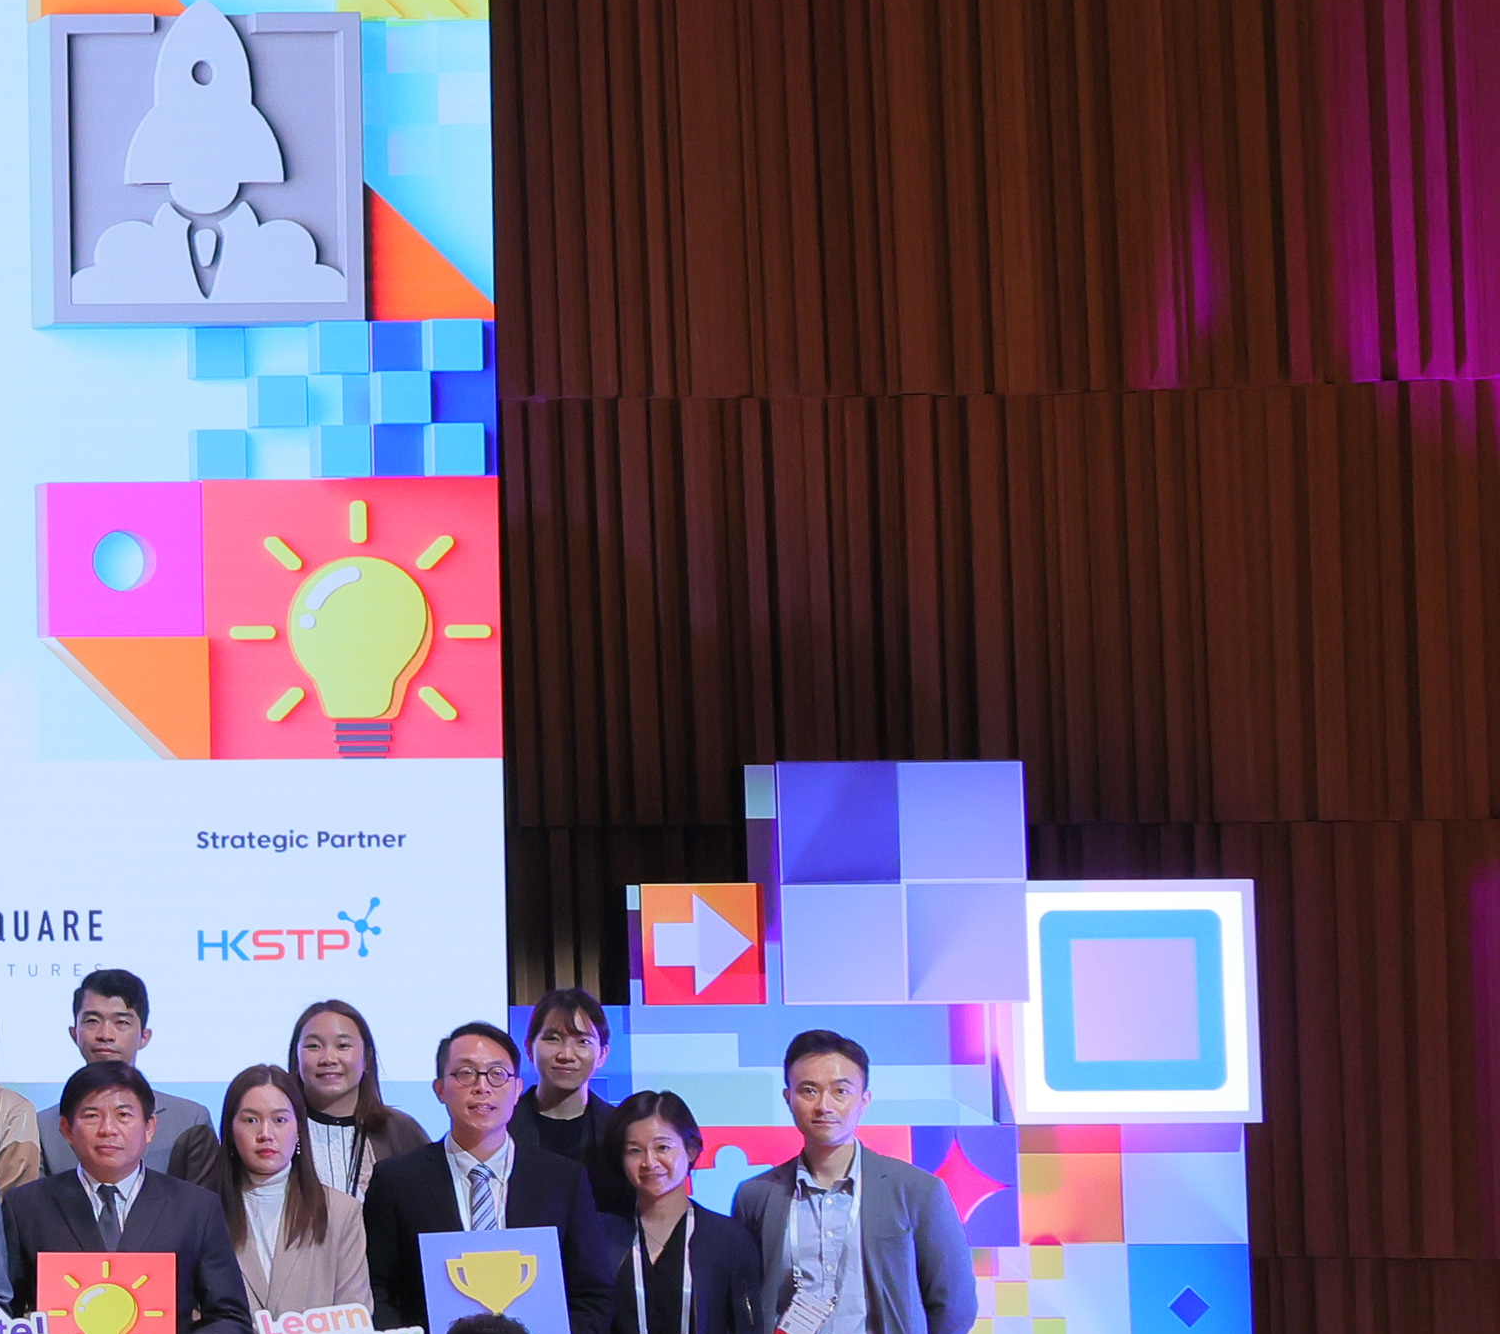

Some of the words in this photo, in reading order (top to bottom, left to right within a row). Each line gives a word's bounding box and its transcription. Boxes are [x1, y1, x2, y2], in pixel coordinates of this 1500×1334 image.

[196, 829, 308, 854] Strategic
[317, 830, 407, 849] Partner
[197, 929, 350, 961] HKSTP
